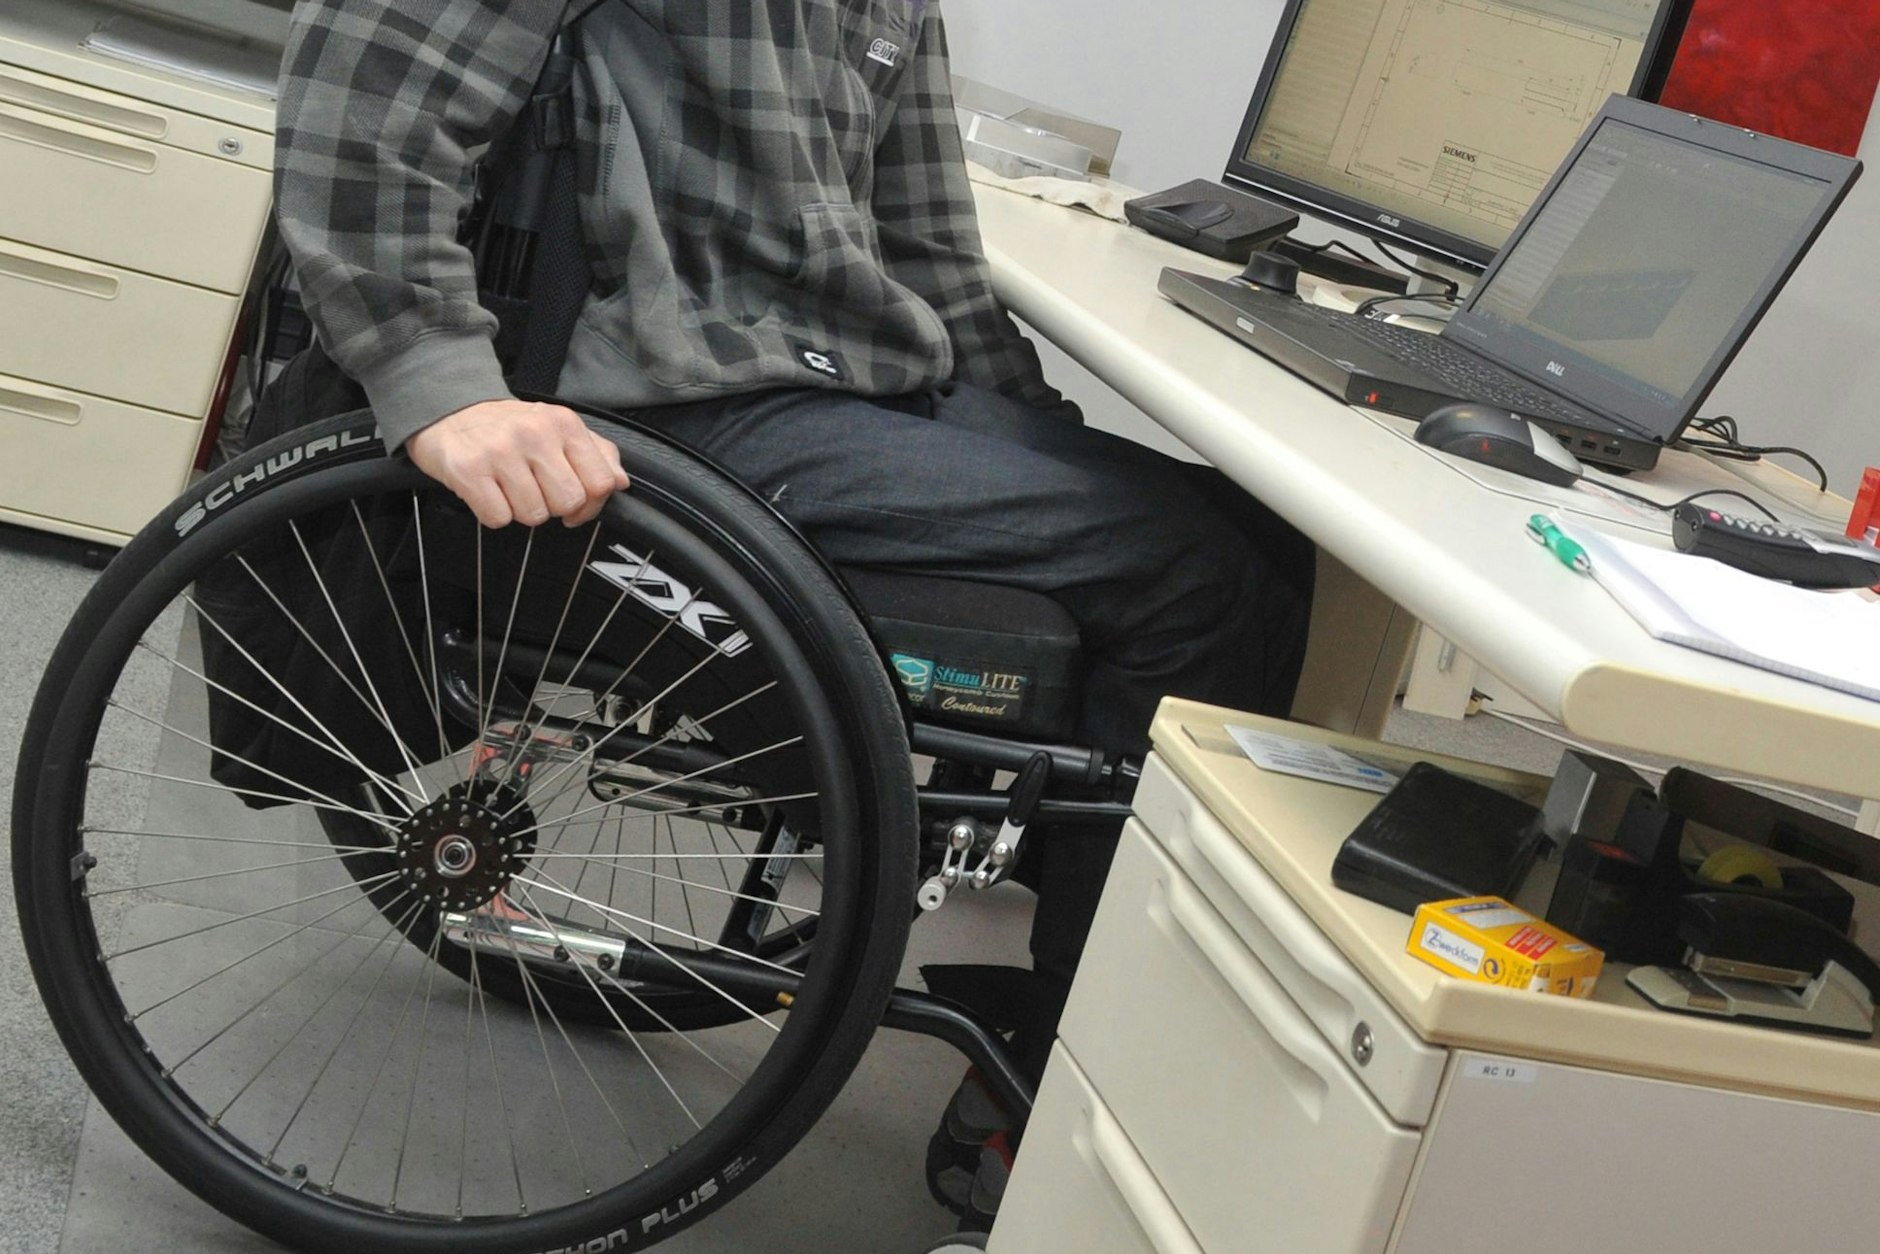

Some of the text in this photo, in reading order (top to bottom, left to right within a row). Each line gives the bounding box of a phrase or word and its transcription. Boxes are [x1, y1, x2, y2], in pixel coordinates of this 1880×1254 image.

[1443, 145, 1477, 163] SIEMENS
[1377, 214, 1400, 228] ASUS
[1545, 360, 1566, 377] DELL
[941, 696, 1007, 717] Contoured
[641, 1177, 720, 1234] PLUS
